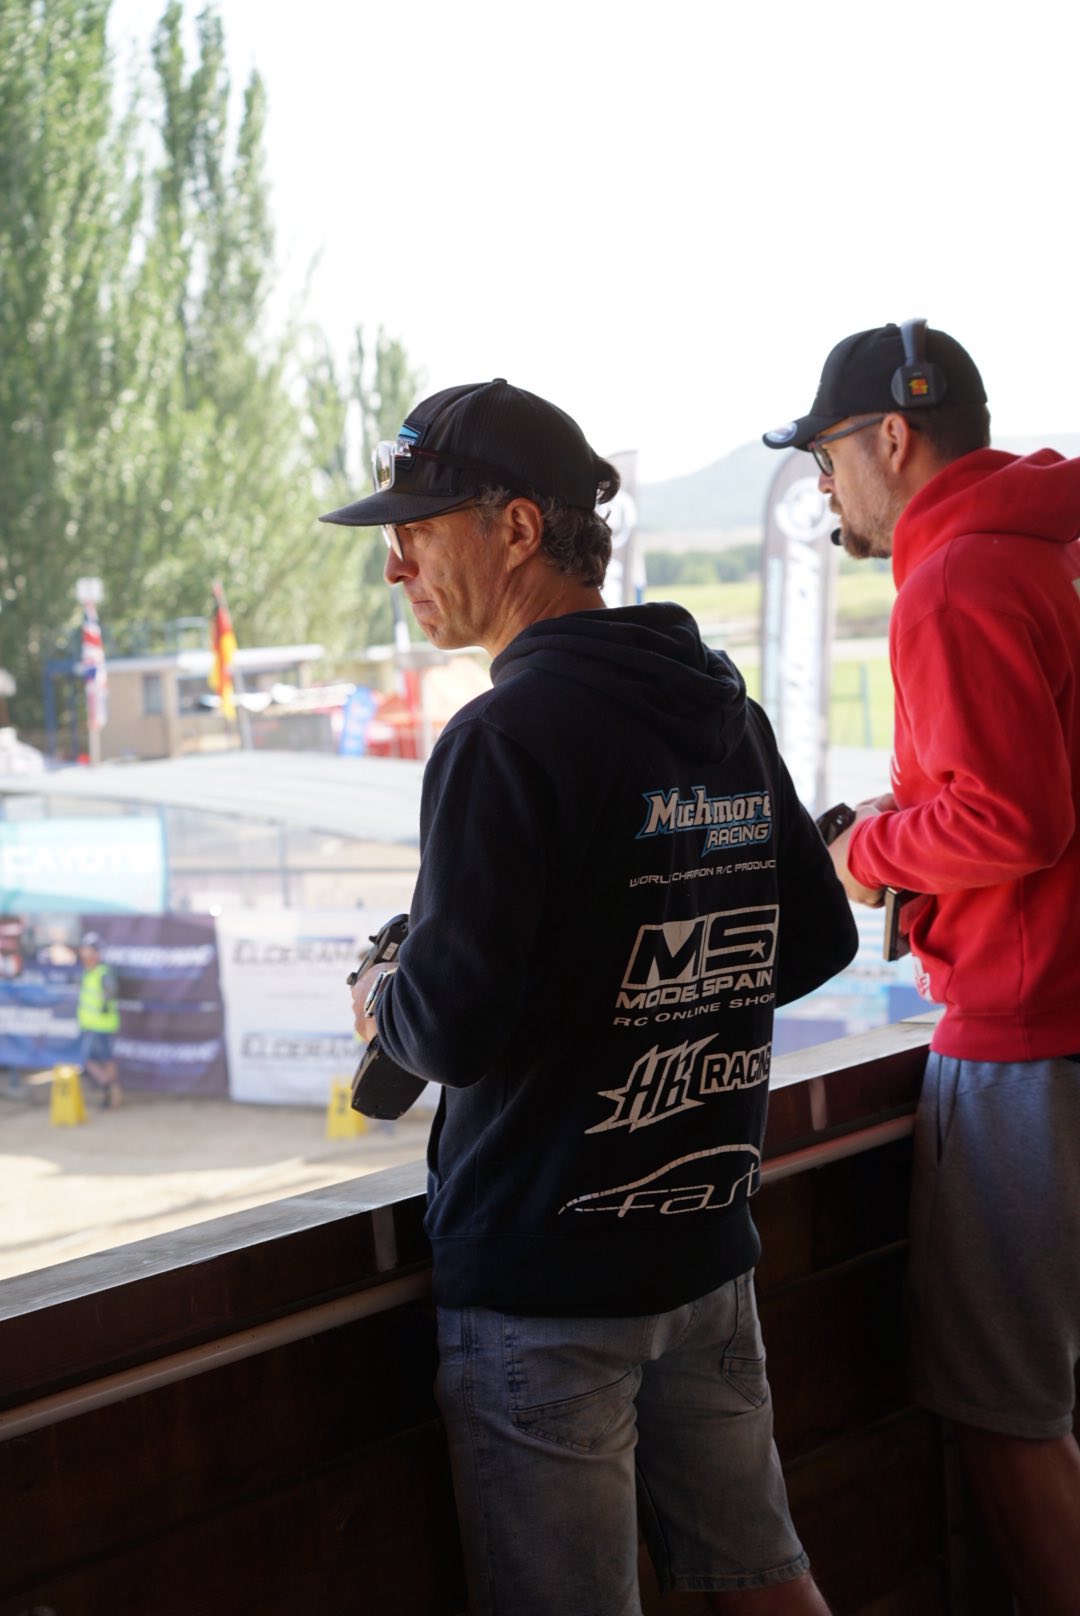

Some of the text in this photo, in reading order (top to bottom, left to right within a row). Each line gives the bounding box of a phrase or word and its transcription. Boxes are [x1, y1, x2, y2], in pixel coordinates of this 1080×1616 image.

[706, 824, 769, 849] RACING
[629, 875, 671, 888] WORL
[734, 859, 776, 872] PRODUC
[613, 993, 775, 1027] RC ONLINE SHOP
